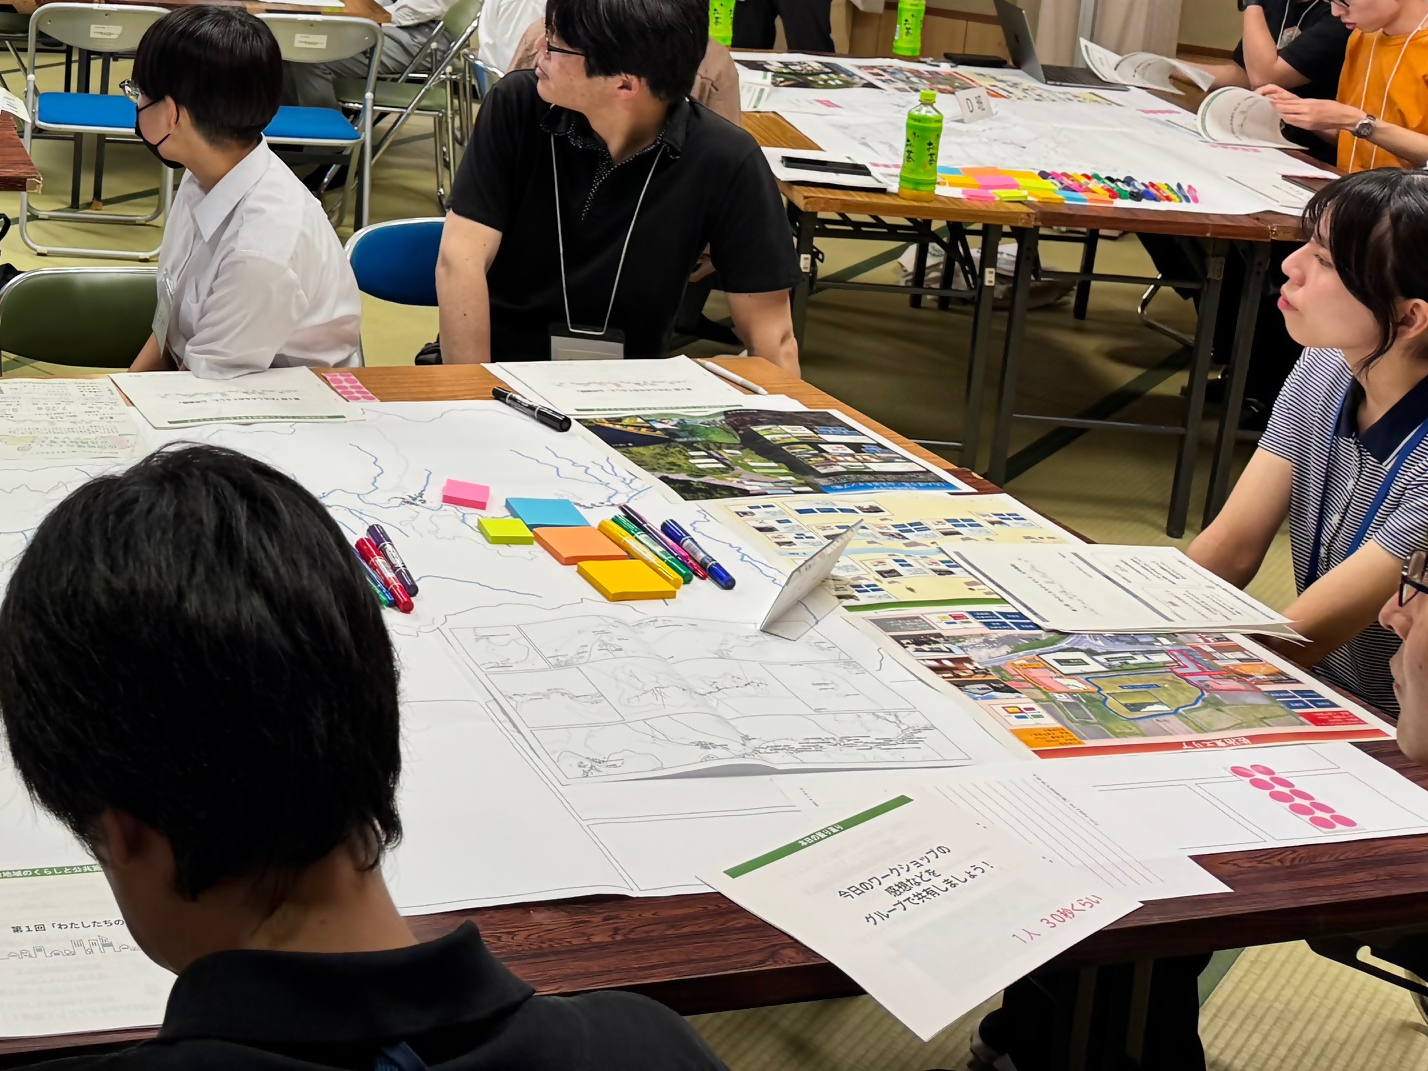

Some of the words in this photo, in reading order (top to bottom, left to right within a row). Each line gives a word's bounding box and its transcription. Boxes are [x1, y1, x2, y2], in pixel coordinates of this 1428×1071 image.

[837, 843, 952, 901] 今日のワークショップの
[864, 858, 995, 927] グループで共有しましょう！
[883, 865, 941, 898] 感想などを
[1040, 893, 1105, 930] 30秒くらい
